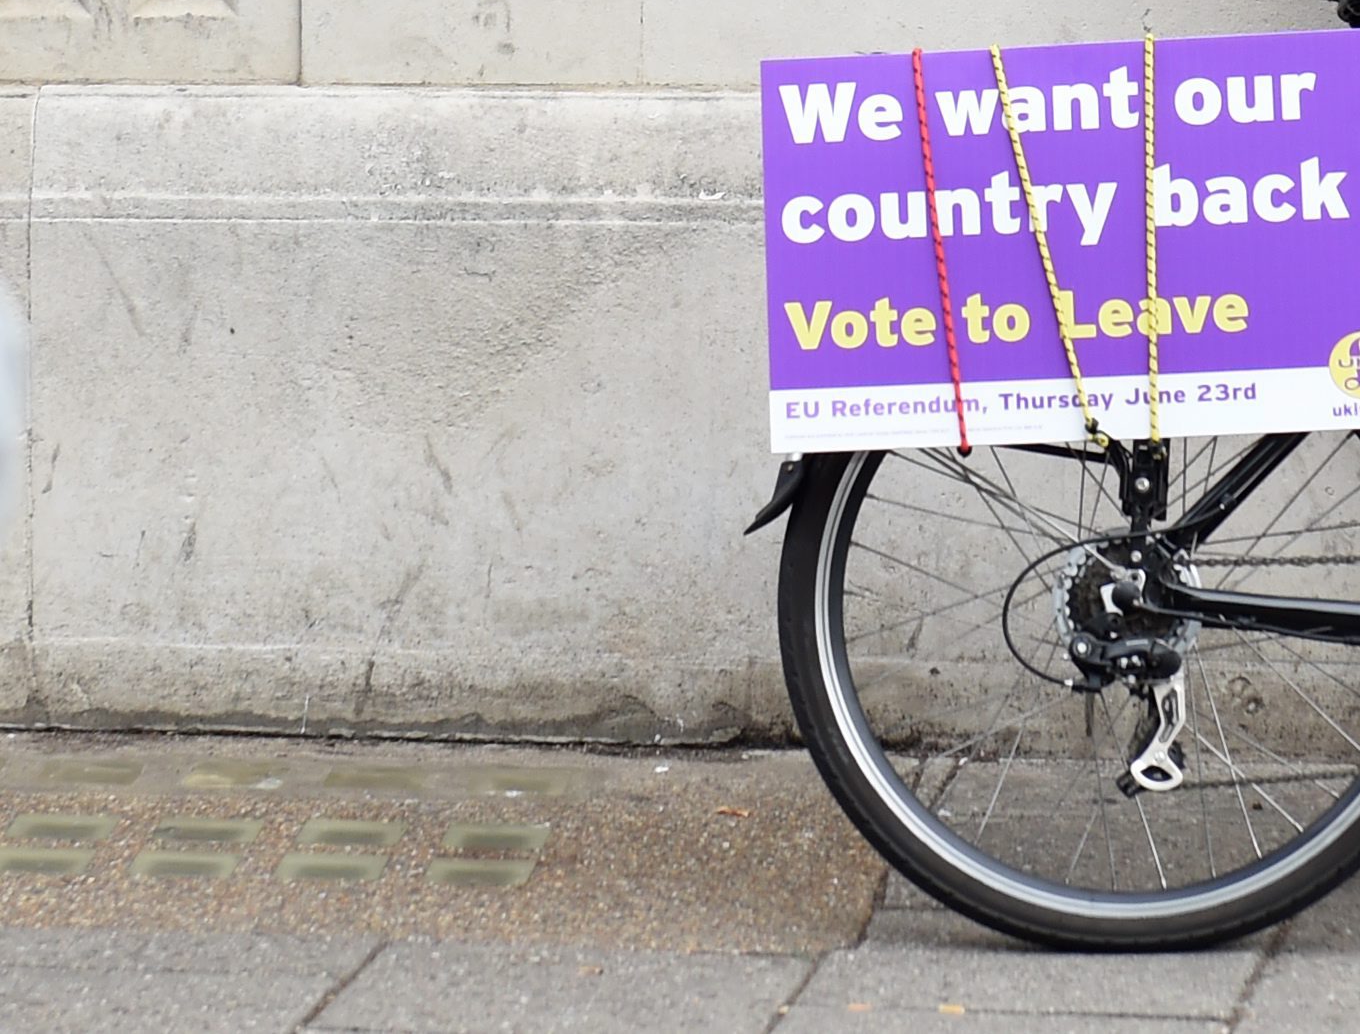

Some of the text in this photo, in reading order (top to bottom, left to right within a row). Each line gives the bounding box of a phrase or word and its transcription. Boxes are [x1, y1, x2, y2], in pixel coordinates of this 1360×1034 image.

[778, 66, 1317, 144] We want our
[781, 156, 1350, 246] country back
[783, 289, 1250, 351] Vote to Leave
[786, 400, 820, 419] EU
[831, 395, 988, 418] Referendum,
[1197, 382, 1258, 403] 23rd
